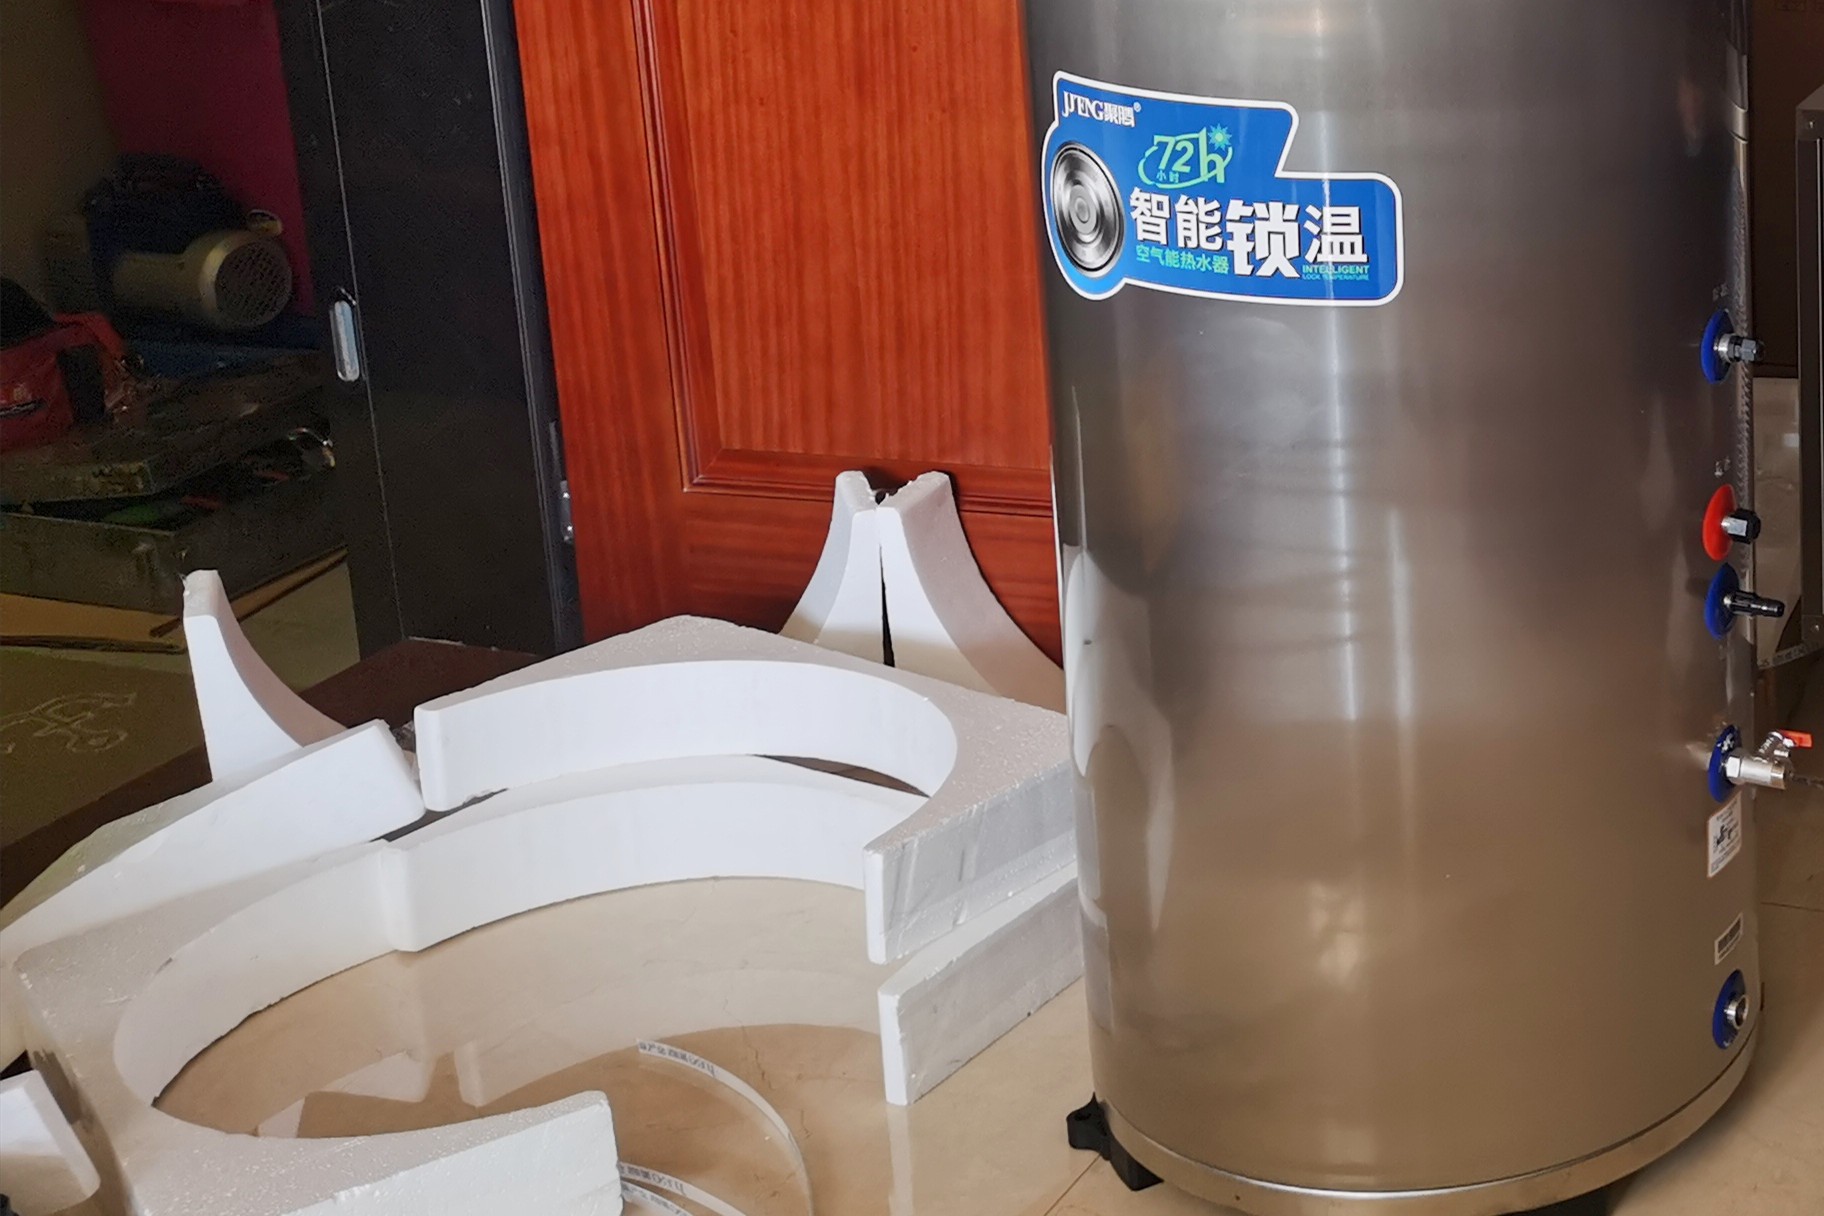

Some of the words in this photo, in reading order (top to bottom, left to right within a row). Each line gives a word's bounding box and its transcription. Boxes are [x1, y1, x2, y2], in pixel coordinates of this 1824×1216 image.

[1129, 187, 1369, 279] 智能锁温
[1136, 244, 1230, 275] 空气能热水器
[1302, 265, 1370, 274] INTELLIGENT
